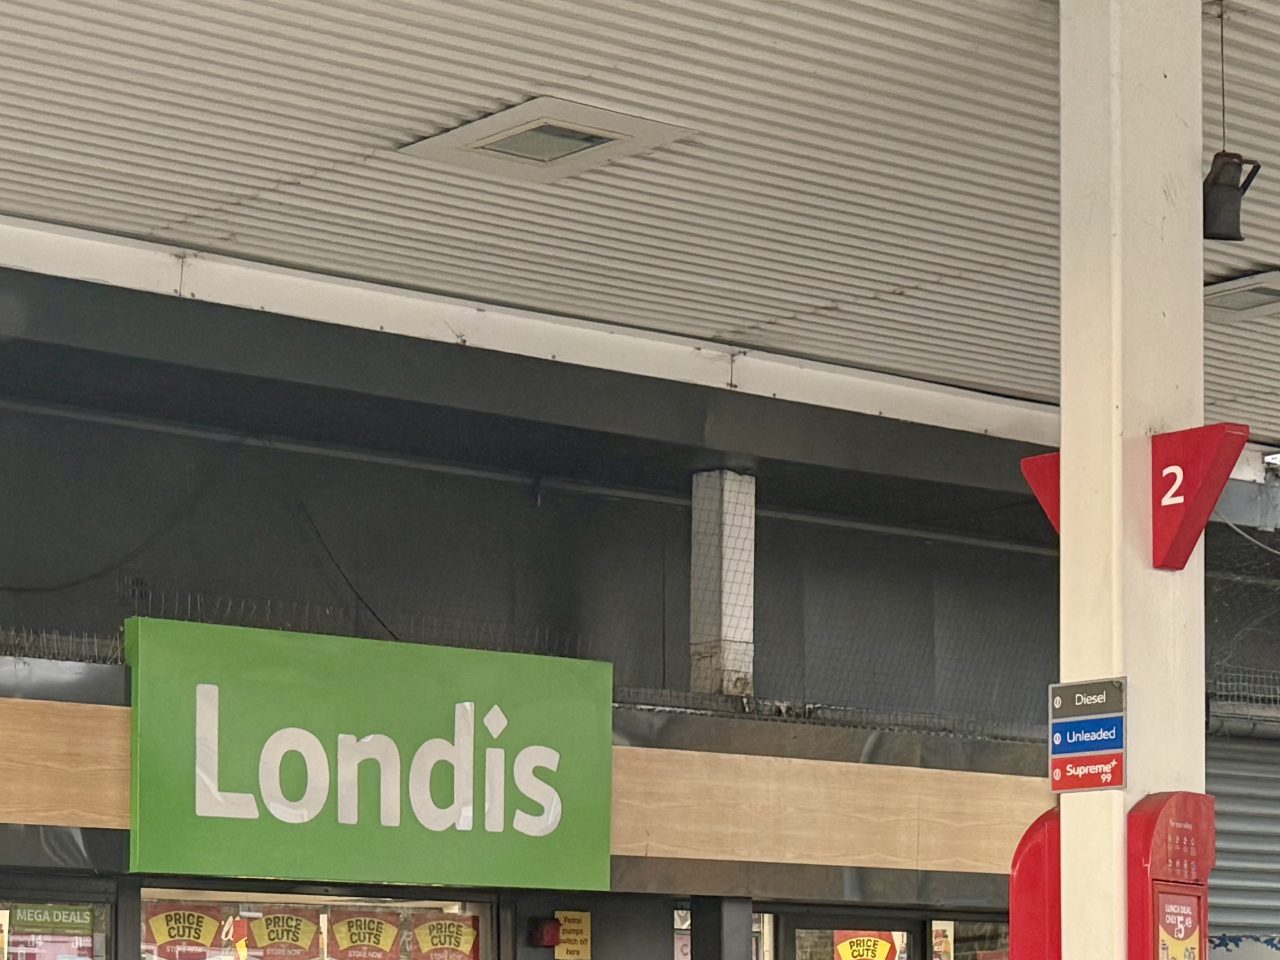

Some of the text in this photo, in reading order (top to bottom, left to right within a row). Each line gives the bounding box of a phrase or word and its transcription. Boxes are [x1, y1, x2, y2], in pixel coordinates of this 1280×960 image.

[1161, 465, 1184, 506] 2
[1075, 690, 1106, 706] Diesel
[1066, 726, 1116, 744] Unleaded
[195, 684, 562, 837] Londis
[1101, 773, 1112, 783] 99
[17, 909, 90, 924] MEGA DEALS
[165, 912, 204, 928] PRICE
[265, 916, 302, 931] PRICE
[168, 925, 202, 940] CUTS
[347, 919, 384, 934] PRICE
[428, 922, 463, 937] PRICE
[268, 929, 300, 942] CUTS
[350, 932, 381, 945] CUTS
[431, 935, 461, 948] CUTS
[849, 938, 879, 950] PRICE
[851, 949, 877, 958] CUTS
